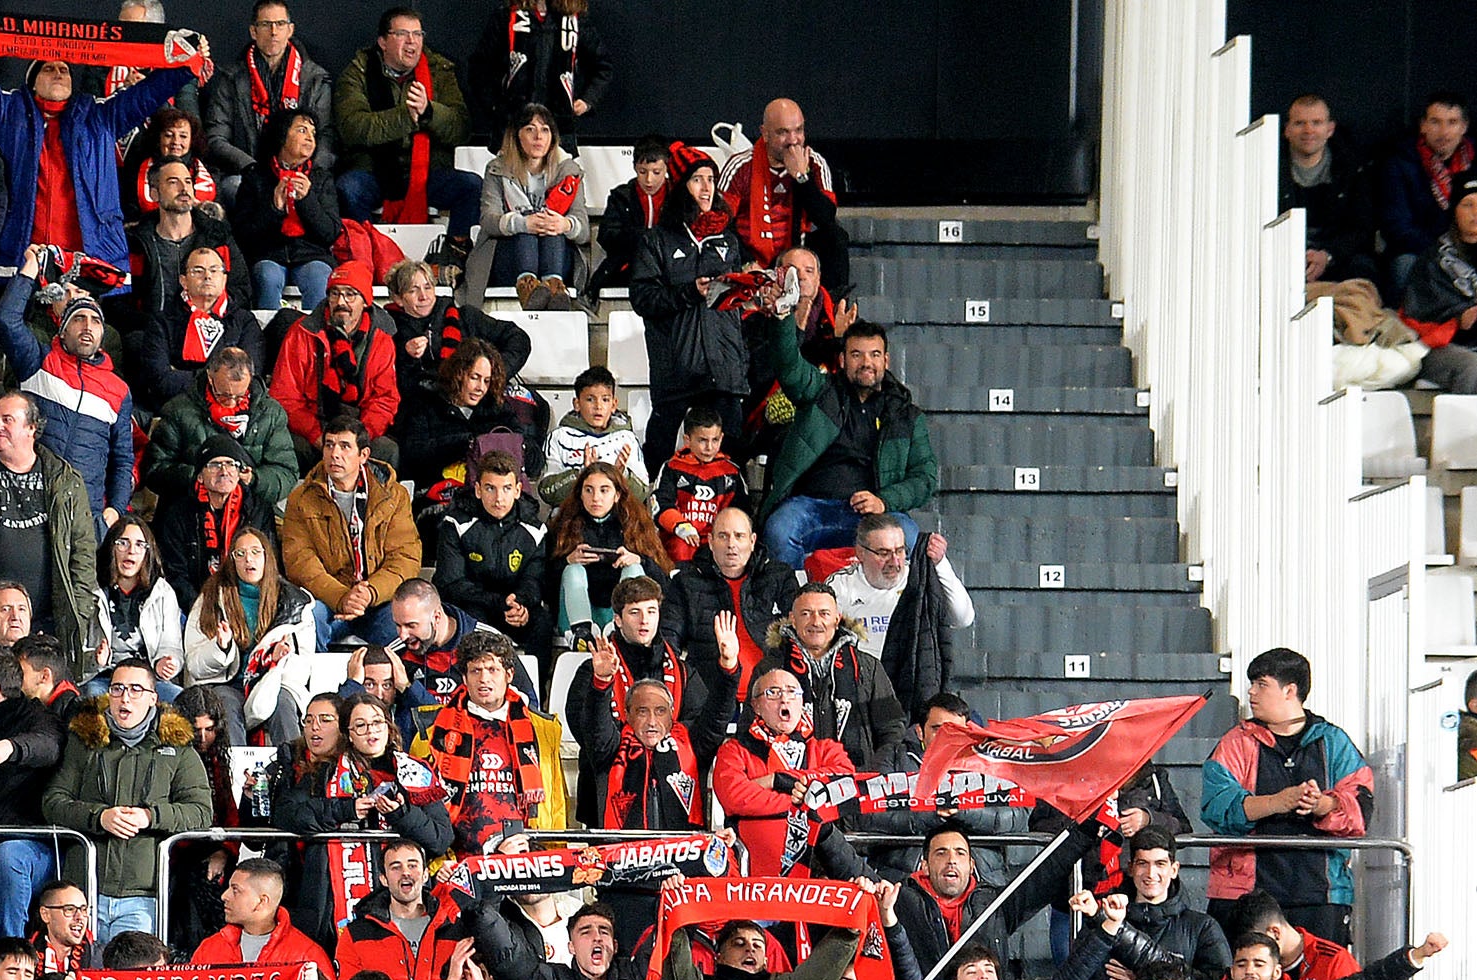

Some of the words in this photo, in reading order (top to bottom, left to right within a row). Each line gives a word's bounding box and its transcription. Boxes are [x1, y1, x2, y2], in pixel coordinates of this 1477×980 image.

[23, 20, 123, 41] MIRANDÉS
[942, 226, 960, 237] 16
[970, 305, 987, 317] 15
[993, 395, 1011, 406] 14
[1019, 473, 1036, 484] 13
[1043, 571, 1061, 582] 12
[1068, 661, 1086, 672] 11
[612, 840, 704, 870] JABATOS
